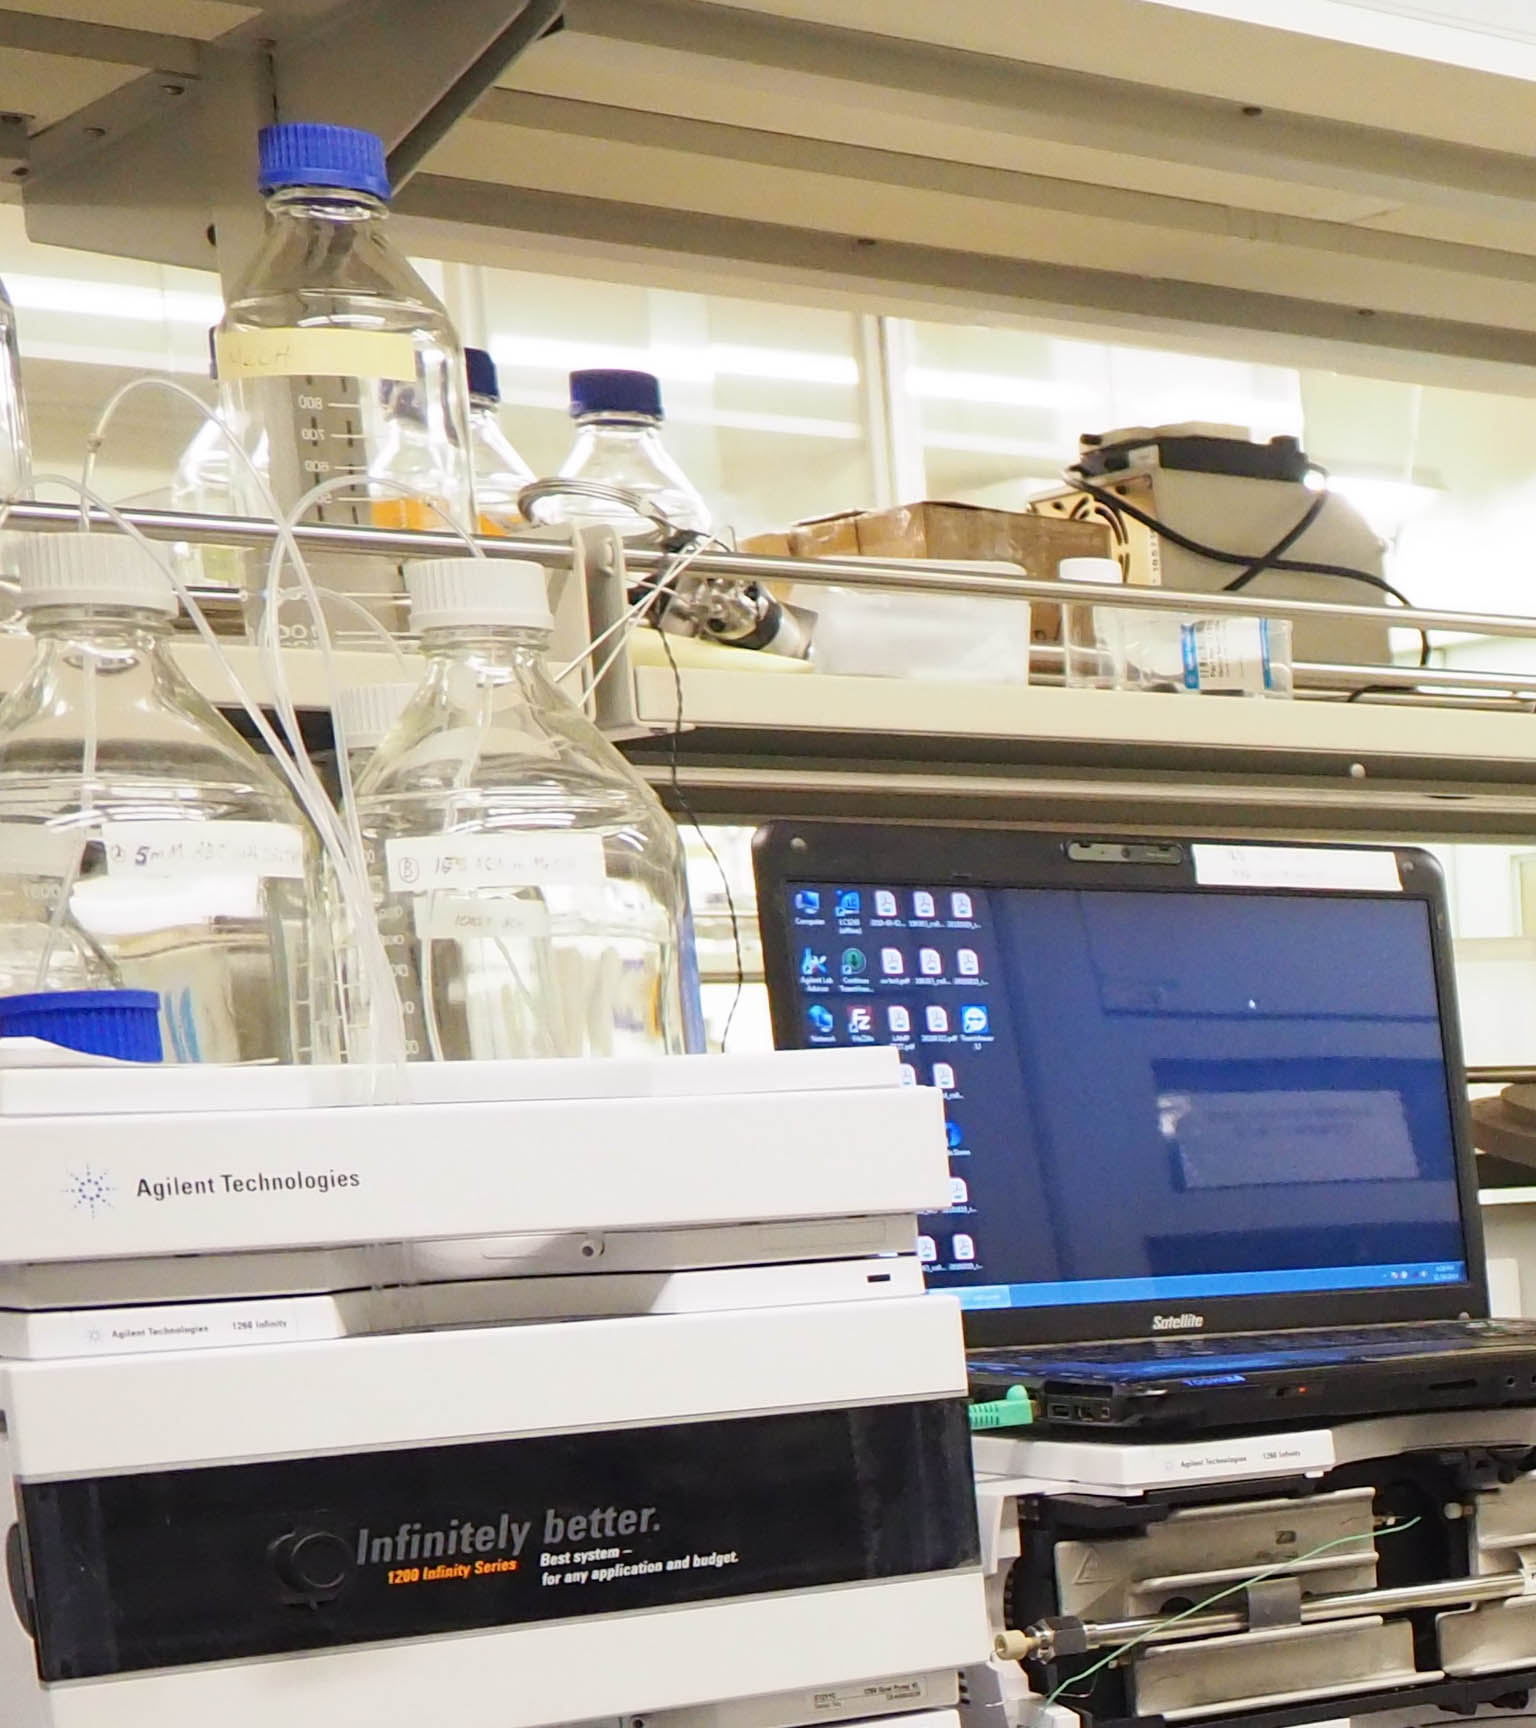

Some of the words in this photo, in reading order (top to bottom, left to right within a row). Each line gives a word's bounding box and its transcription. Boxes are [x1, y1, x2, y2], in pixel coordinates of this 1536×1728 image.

[136, 1177, 214, 1201] Agilent
[220, 1169, 361, 1192] Technologies
[111, 1327, 146, 1341] Agilent
[148, 1324, 209, 1337] Technologies
[1152, 1313, 1204, 1330] Satellite
[356, 1512, 531, 1566] Infinitely
[543, 1505, 661, 1545] better.
[540, 1553, 570, 1568] Best
[572, 1547, 621, 1565] system
[541, 1571, 561, 1588] for
[563, 1569, 588, 1587] any
[590, 1558, 663, 1583] application
[665, 1555, 691, 1572] and
[692, 1550, 740, 1568] budget.
[387, 1569, 420, 1585] 1200
[422, 1563, 472, 1582] Infinity
[474, 1558, 518, 1574] Series
